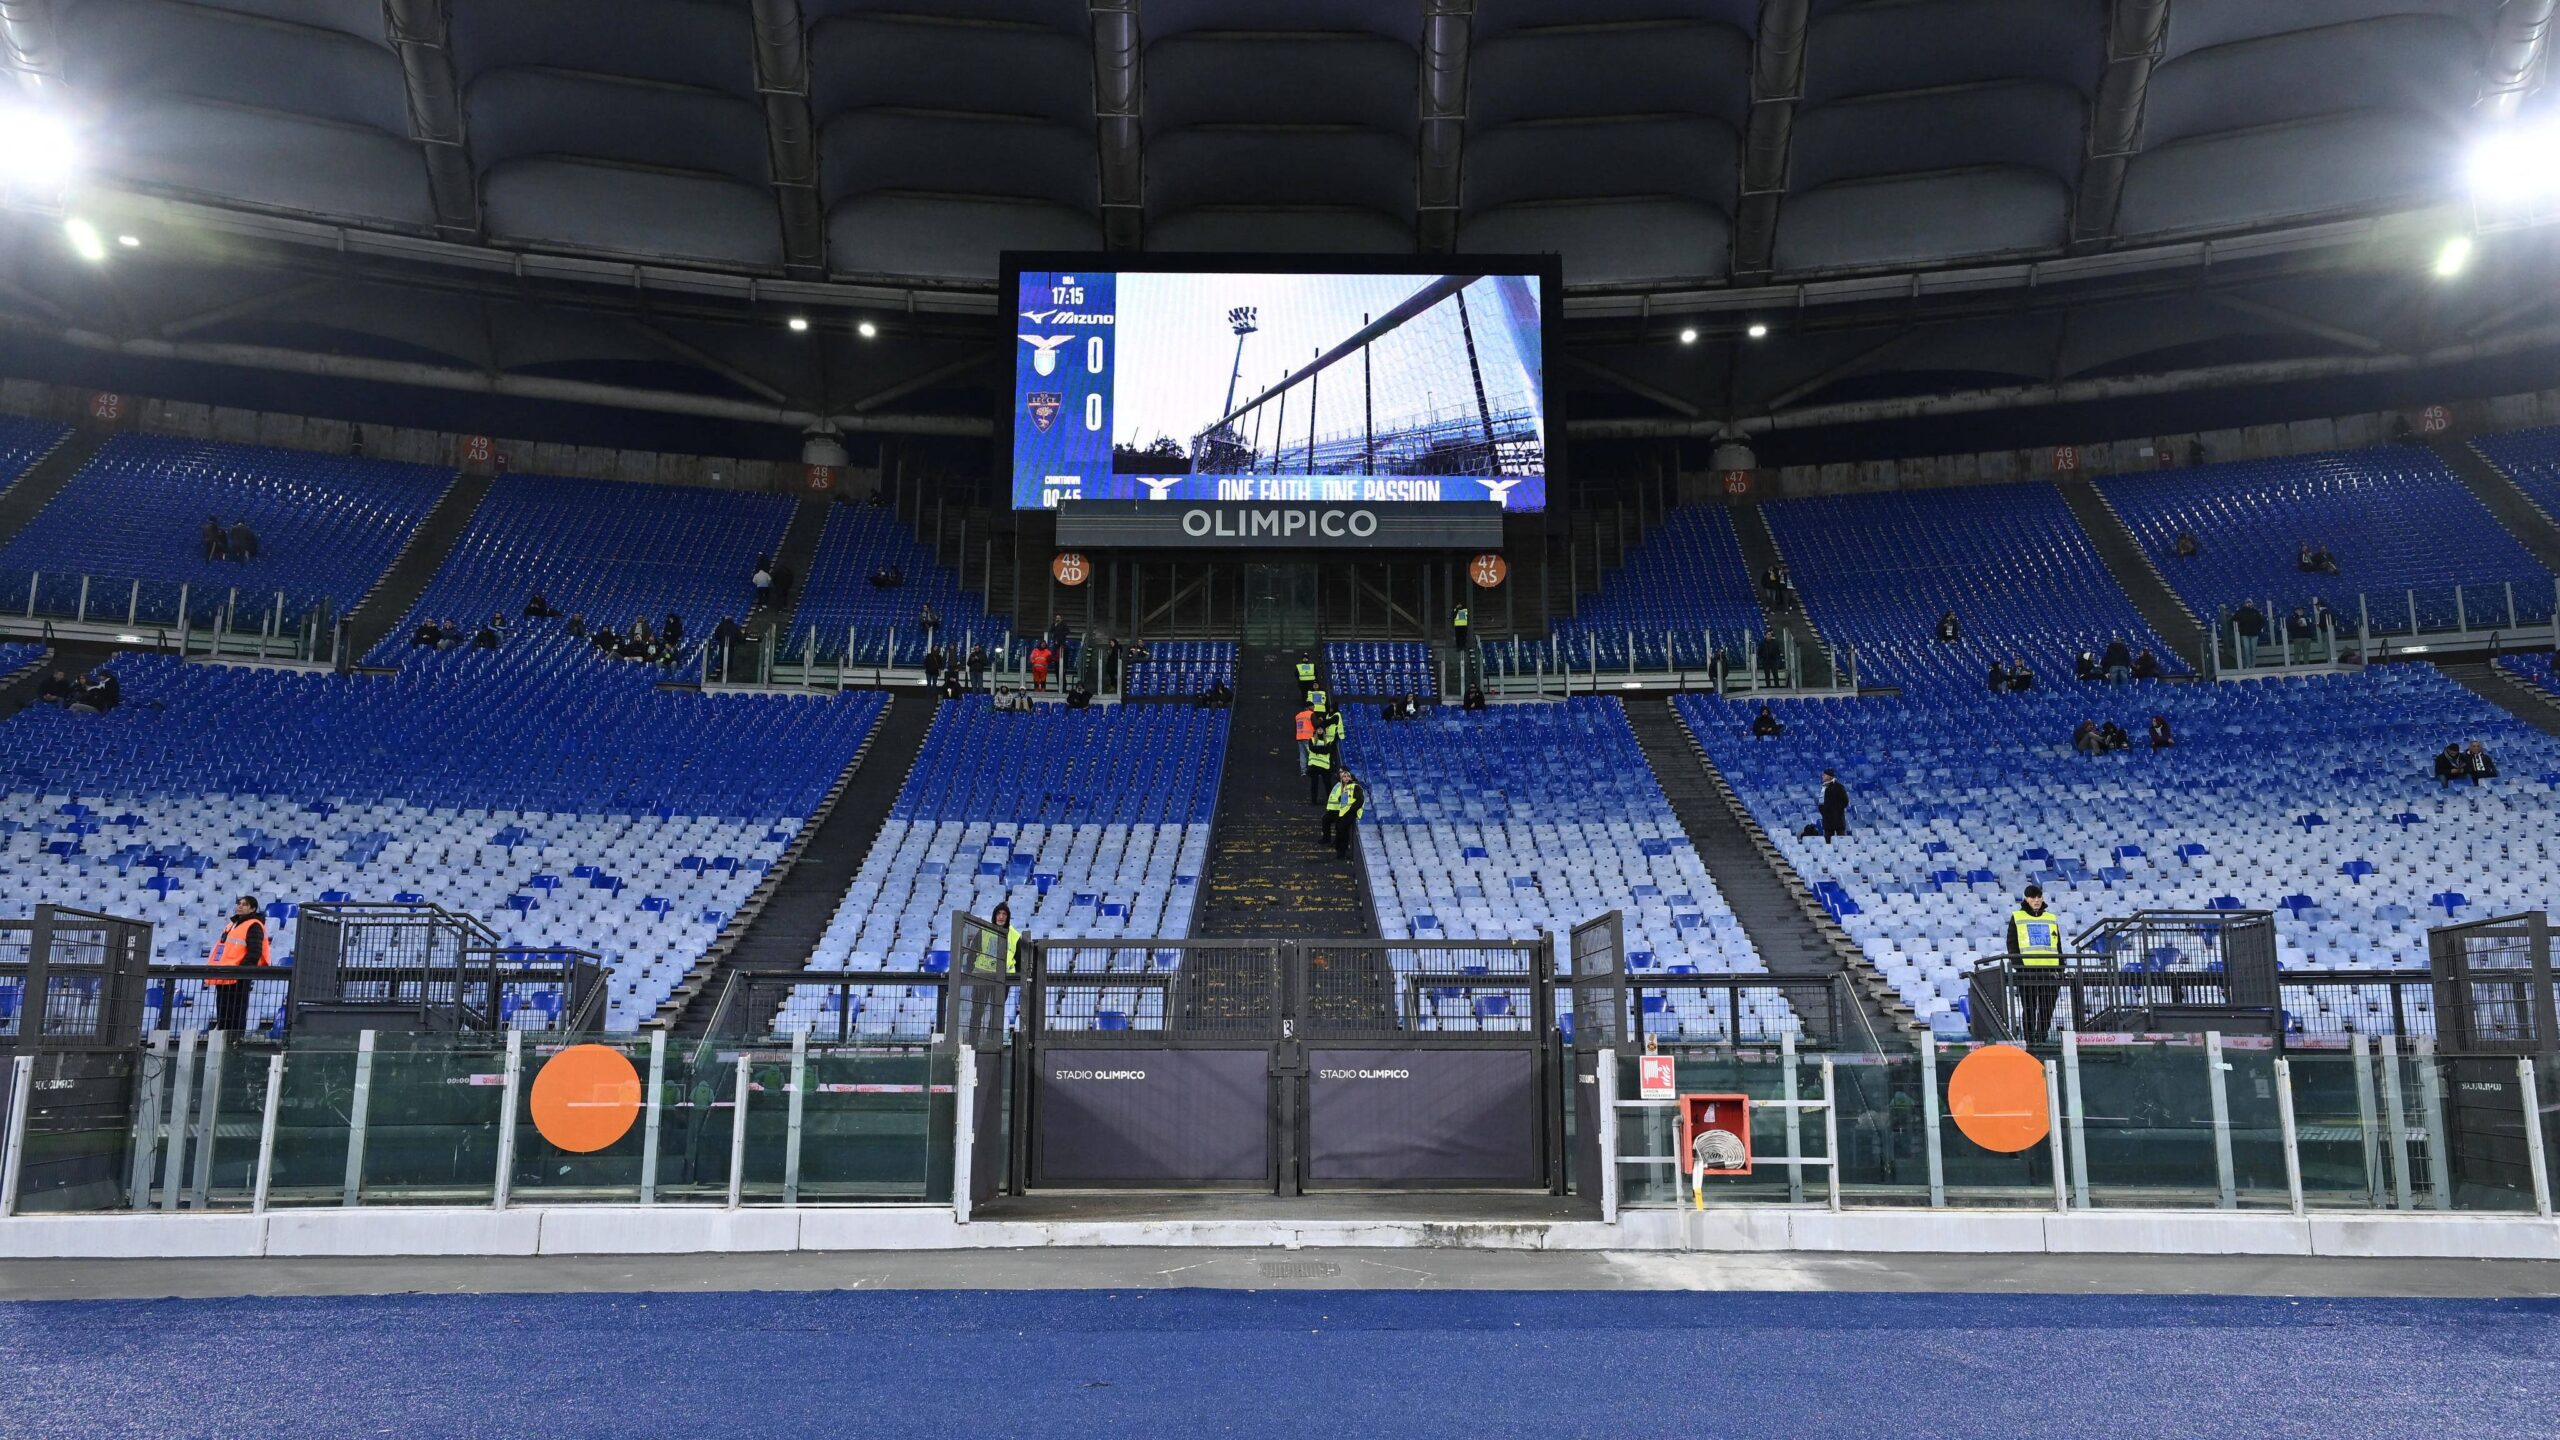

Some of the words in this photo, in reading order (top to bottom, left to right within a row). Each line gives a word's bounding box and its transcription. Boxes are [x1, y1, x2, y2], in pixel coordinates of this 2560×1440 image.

[1052, 287, 1084, 305] 17:15
[1087, 336, 1104, 374] 0
[98, 393, 118, 406] 49
[96, 405, 117, 419] AS
[1085, 393, 1102, 432] 0
[2424, 406, 2443, 419] 46
[2424, 418, 2446, 432] AD
[471, 436, 489, 449] 49
[468, 448, 489, 461] AD
[2056, 447, 2073, 458] 46
[2057, 458, 2074, 471] AS
[813, 466, 828, 478] 48
[1730, 471, 1744, 482] 47
[811, 477, 828, 489] AS
[1728, 482, 1746, 493] AD
[1217, 479, 1254, 501] ONE
[1322, 479, 1358, 501] ONE
[1363, 480, 1440, 501] PASSION
[1182, 509, 1378, 537] OLIMPICO
[1062, 553, 1081, 567] 48
[1478, 555, 1497, 569] 47
[1060, 567, 1082, 581] AD
[1477, 569, 1498, 584] AS
[1056, 1070, 1093, 1080] STADIO
[1094, 1070, 1146, 1080] OLIMPICO
[1320, 1069, 1357, 1079] STADIO
[1359, 1069, 1409, 1079] OLIMPICO
